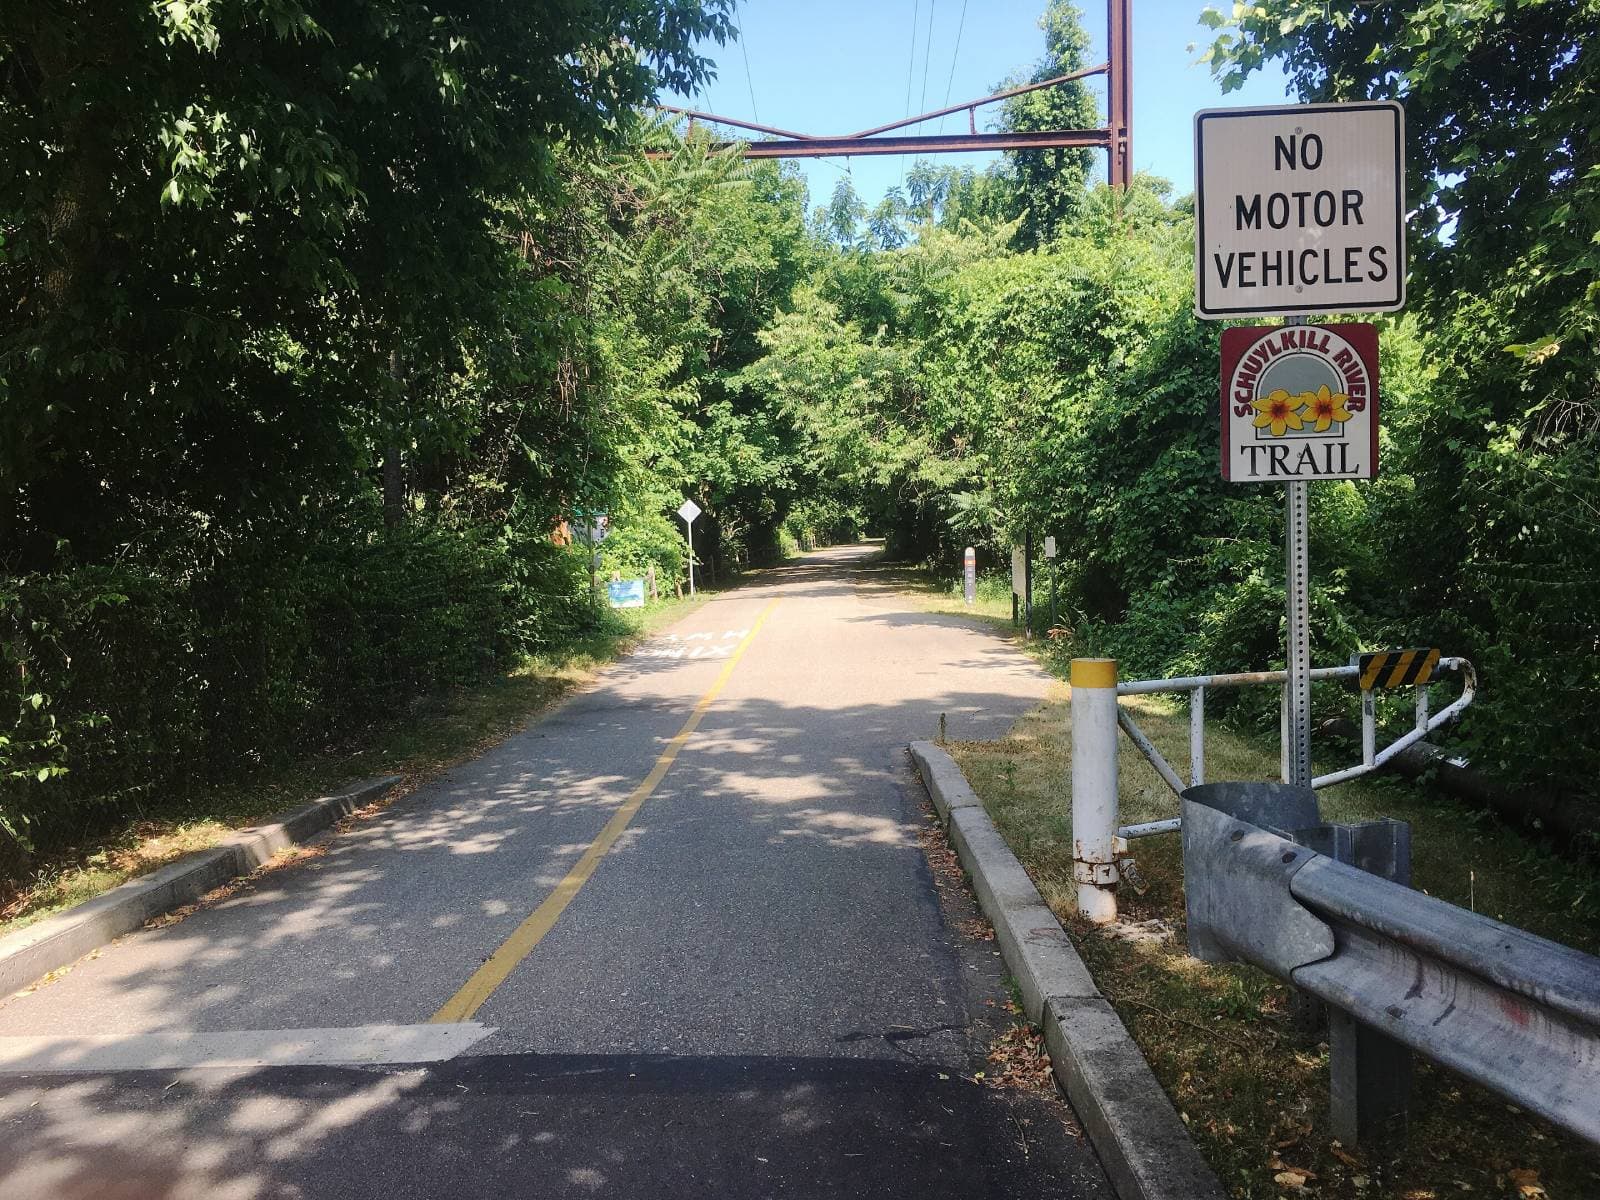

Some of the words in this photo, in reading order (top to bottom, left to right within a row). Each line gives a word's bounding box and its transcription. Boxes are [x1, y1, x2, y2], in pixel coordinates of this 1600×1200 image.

[1274, 133, 1323, 171] NO
[1236, 189, 1364, 230] MOTOR
[1214, 245, 1388, 288] VEHICLES
[1233, 329, 1331, 418] SCHUYLKILL
[1332, 347, 1367, 413] RIVER
[1240, 442, 1360, 476] TRAIL
